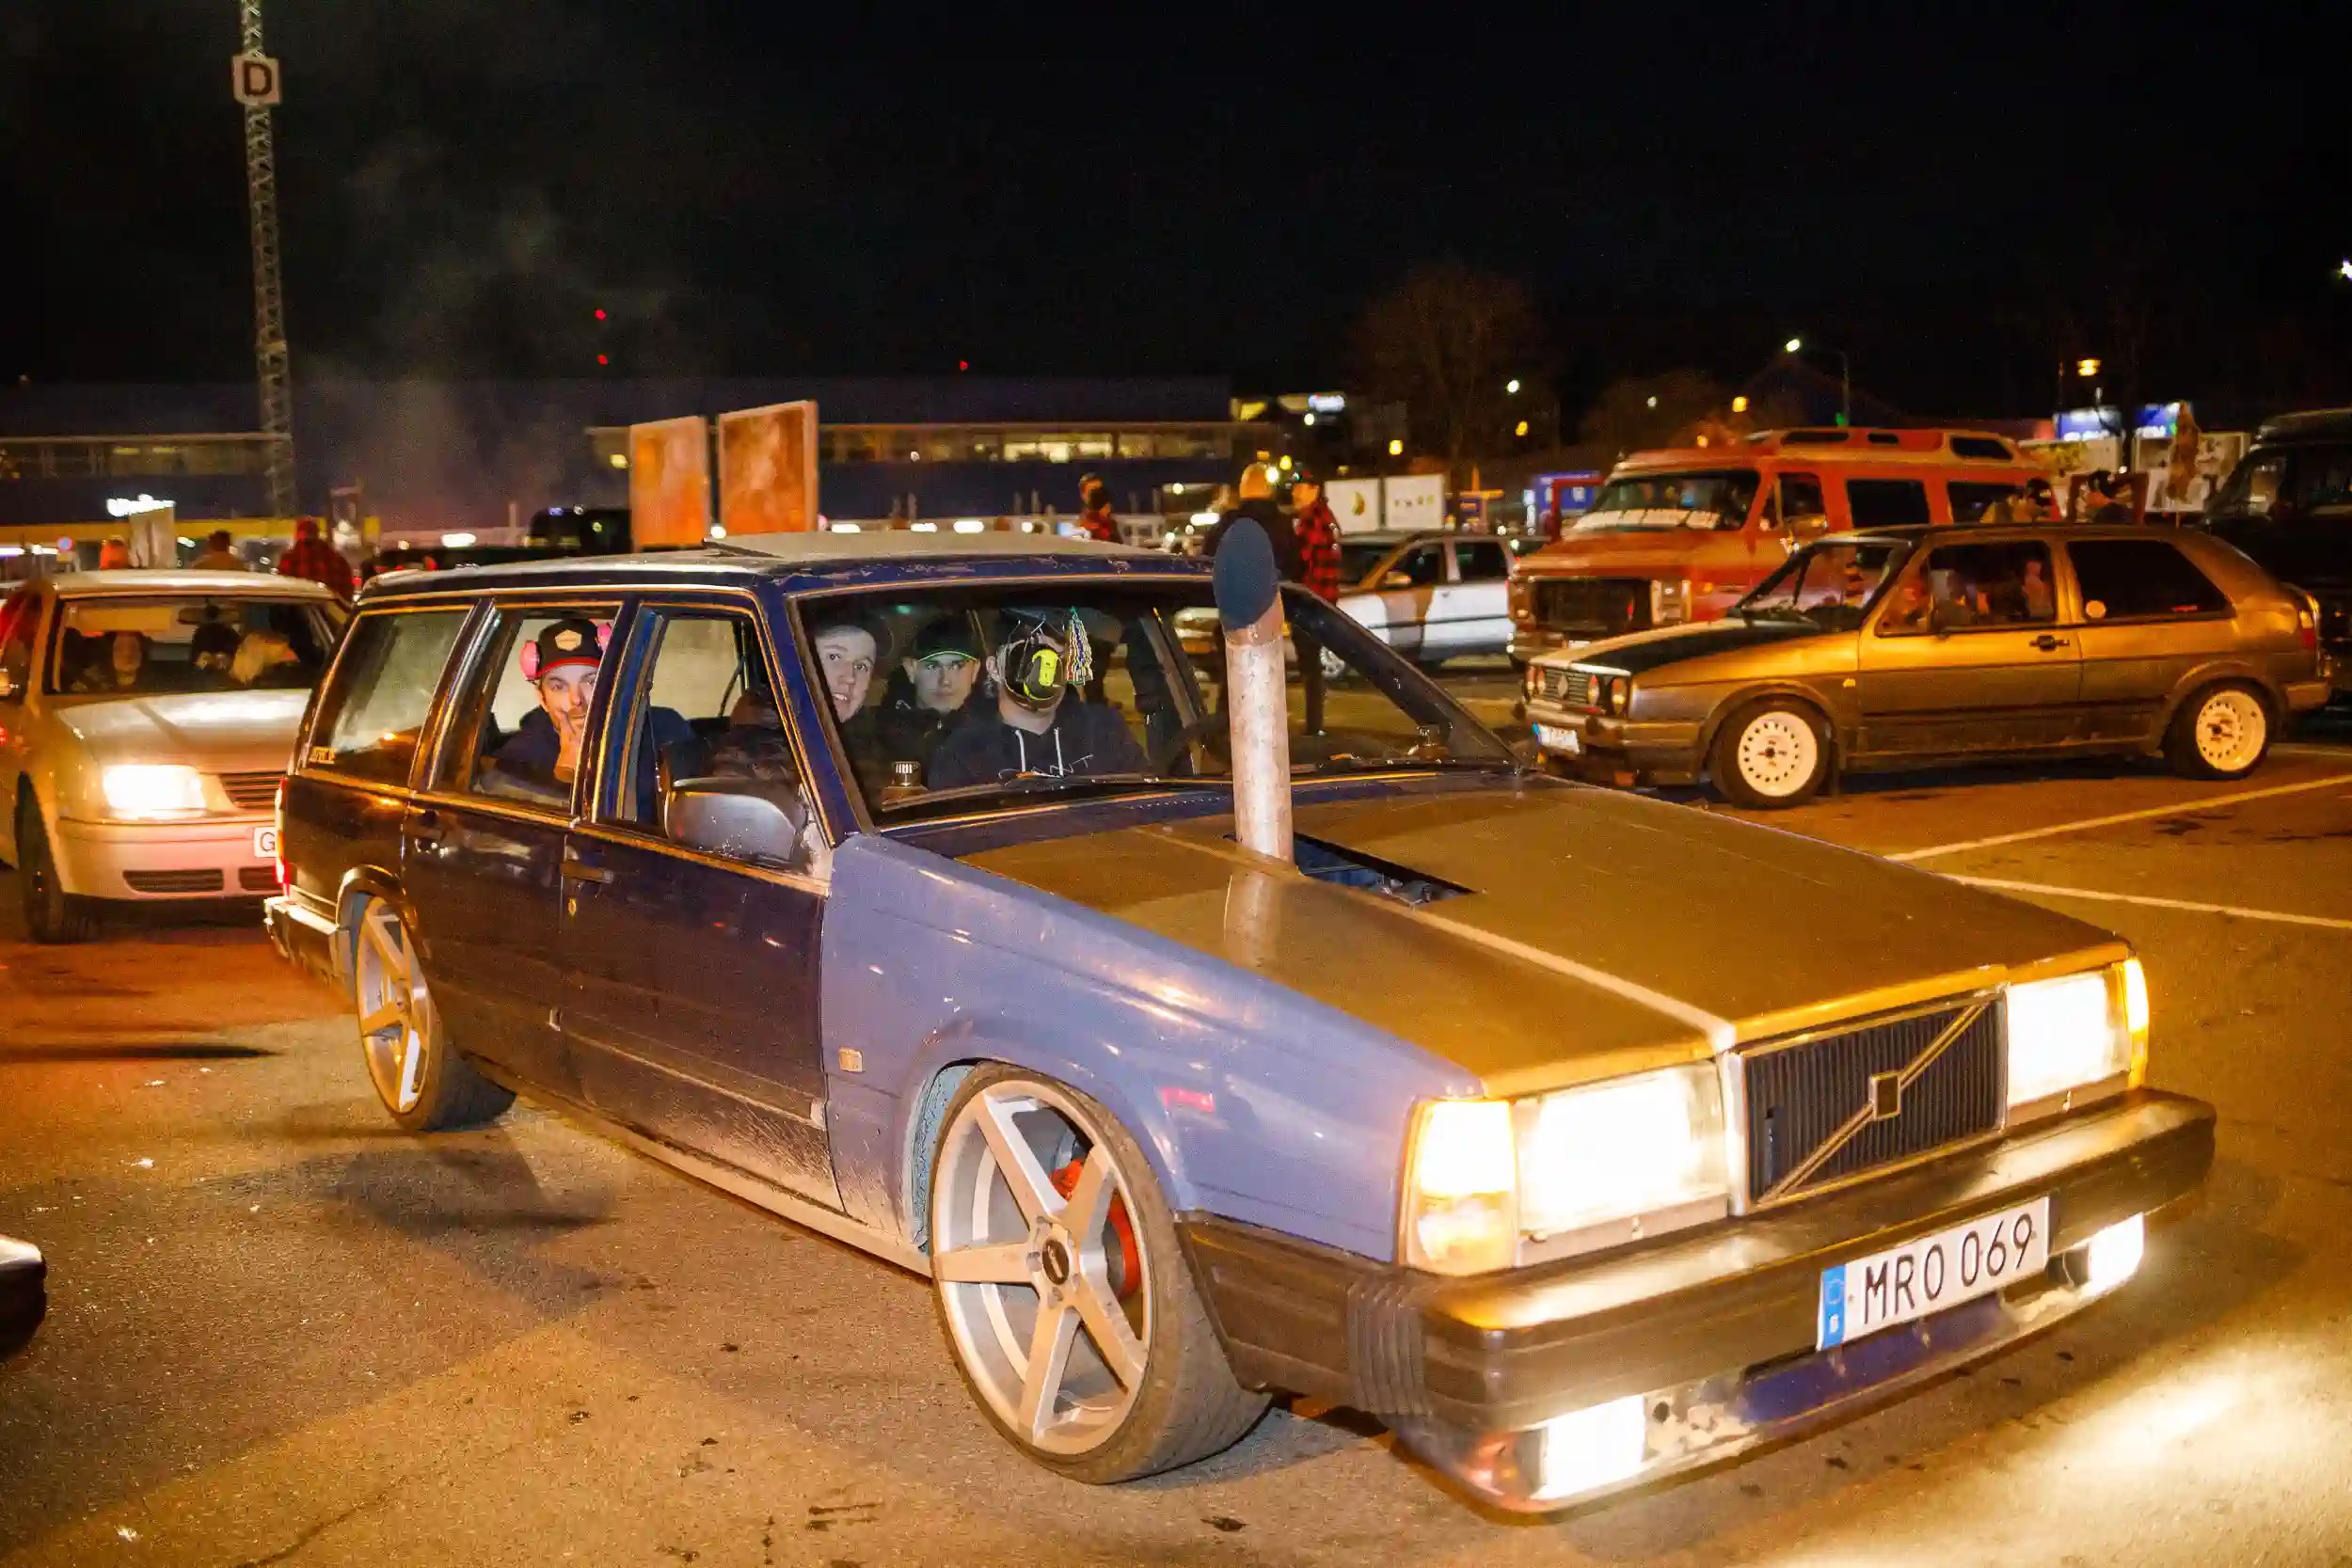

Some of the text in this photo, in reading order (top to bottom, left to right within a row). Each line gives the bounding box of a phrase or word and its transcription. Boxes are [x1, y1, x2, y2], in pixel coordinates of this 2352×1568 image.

[243, 60, 272, 96] D
[1864, 1212, 2033, 1324] MRO 069
